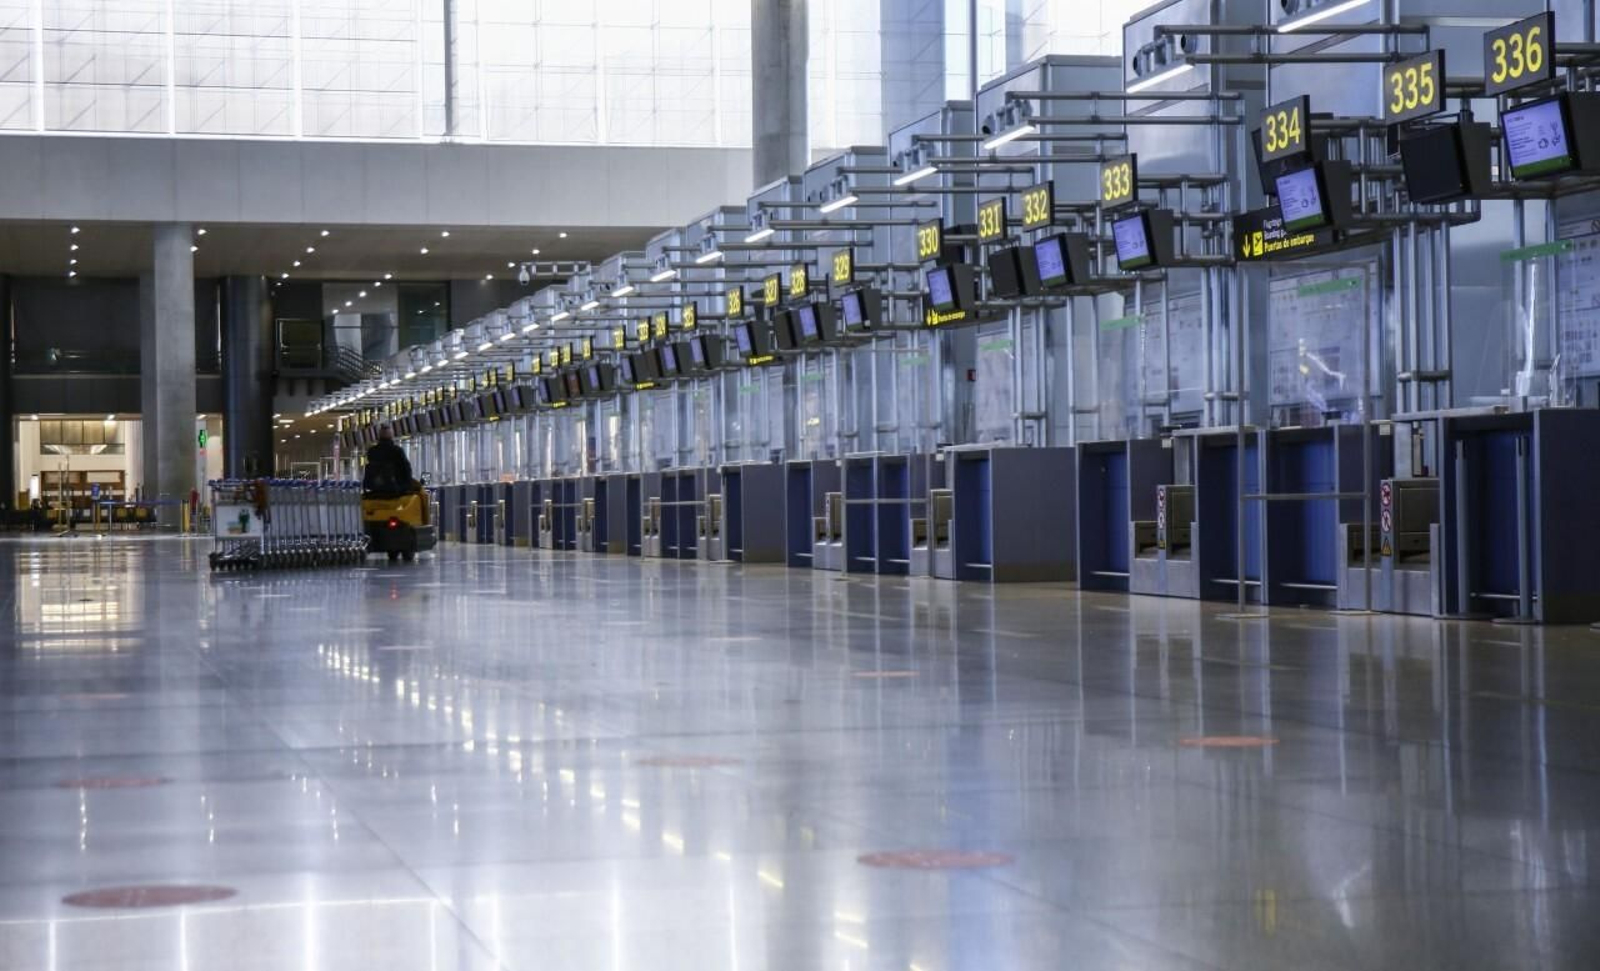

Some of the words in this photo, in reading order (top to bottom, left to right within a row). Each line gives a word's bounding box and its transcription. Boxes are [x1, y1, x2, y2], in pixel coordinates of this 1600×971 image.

[1491, 26, 1543, 84] 336
[1390, 63, 1435, 114] 335
[1265, 107, 1301, 152] 334
[1104, 164, 1131, 200] 333
[979, 207, 1001, 238] 331
[1024, 190, 1048, 226] 332
[919, 228, 939, 257] 330
[1264, 240, 1282, 252] Puertas
[1283, 238, 1290, 248] de
[1290, 234, 1314, 246] embarque
[834, 255, 850, 281] 329
